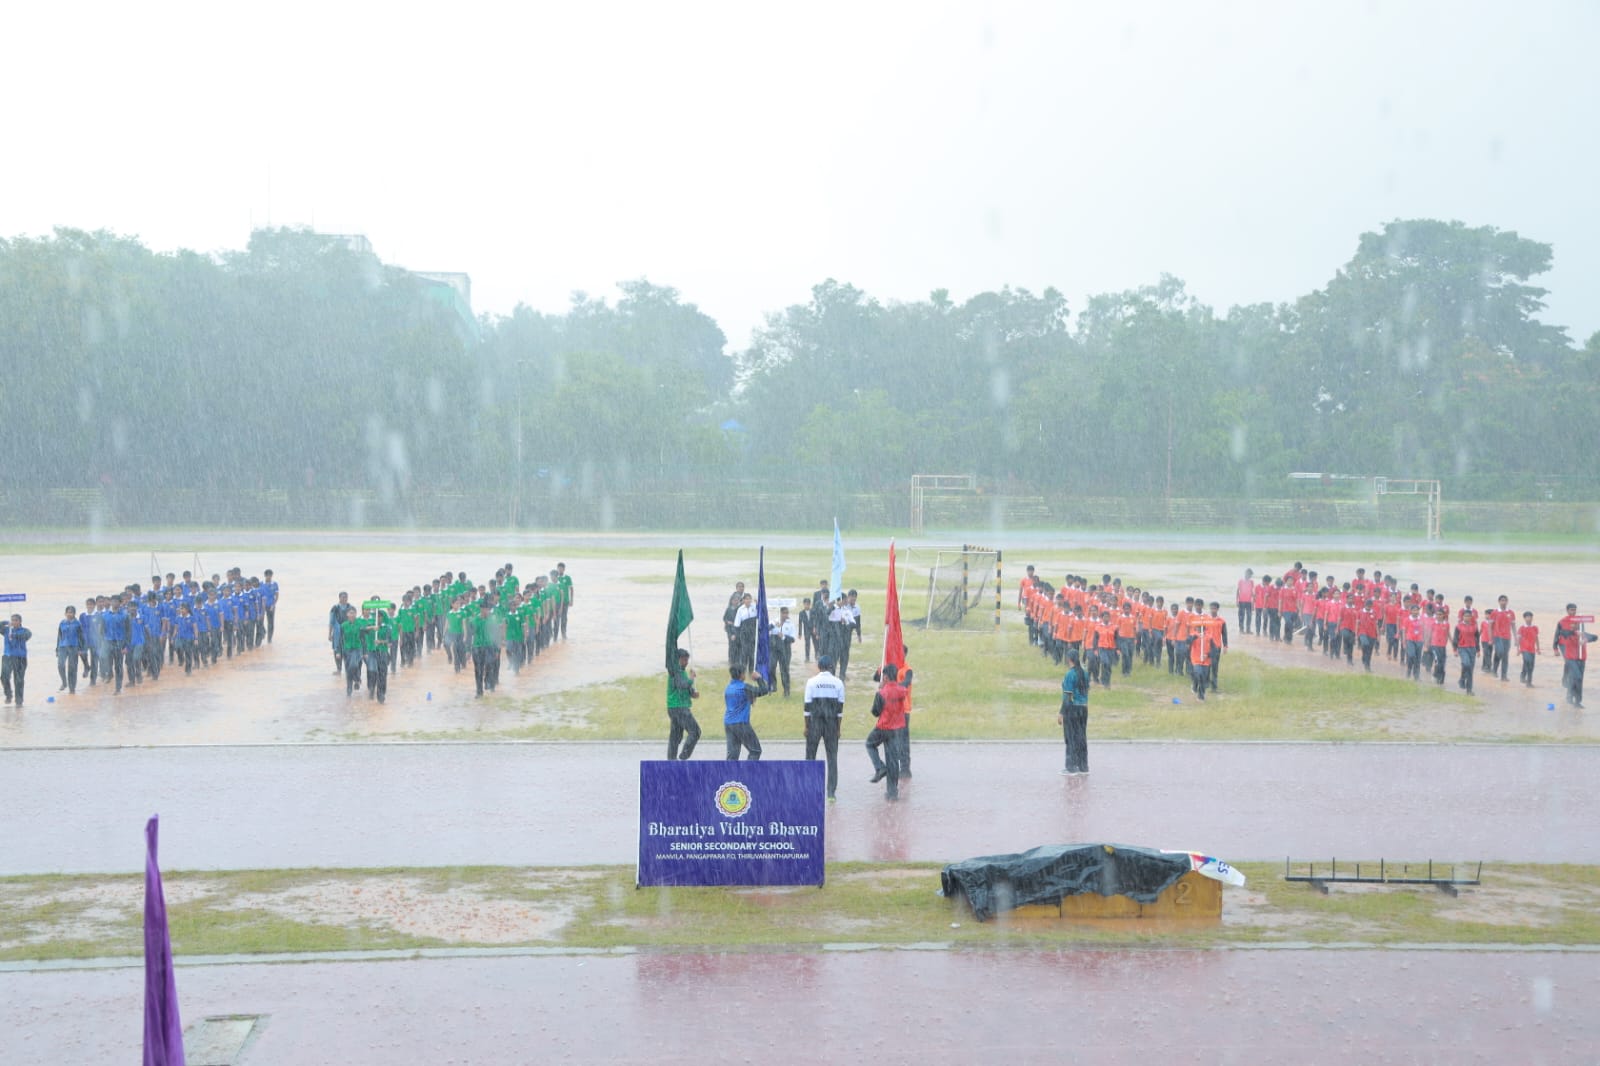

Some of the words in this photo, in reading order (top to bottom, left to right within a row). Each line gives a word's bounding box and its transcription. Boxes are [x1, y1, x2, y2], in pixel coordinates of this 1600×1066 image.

[649, 822, 715, 838] Bharatiya
[720, 822, 764, 838] Vidhya
[769, 821, 818, 837] Bhavan
[670, 842, 703, 850] SENIOR
[704, 842, 757, 850] SECONDARY
[759, 842, 794, 850] SCHOOL
[1175, 882, 1192, 904] 2
